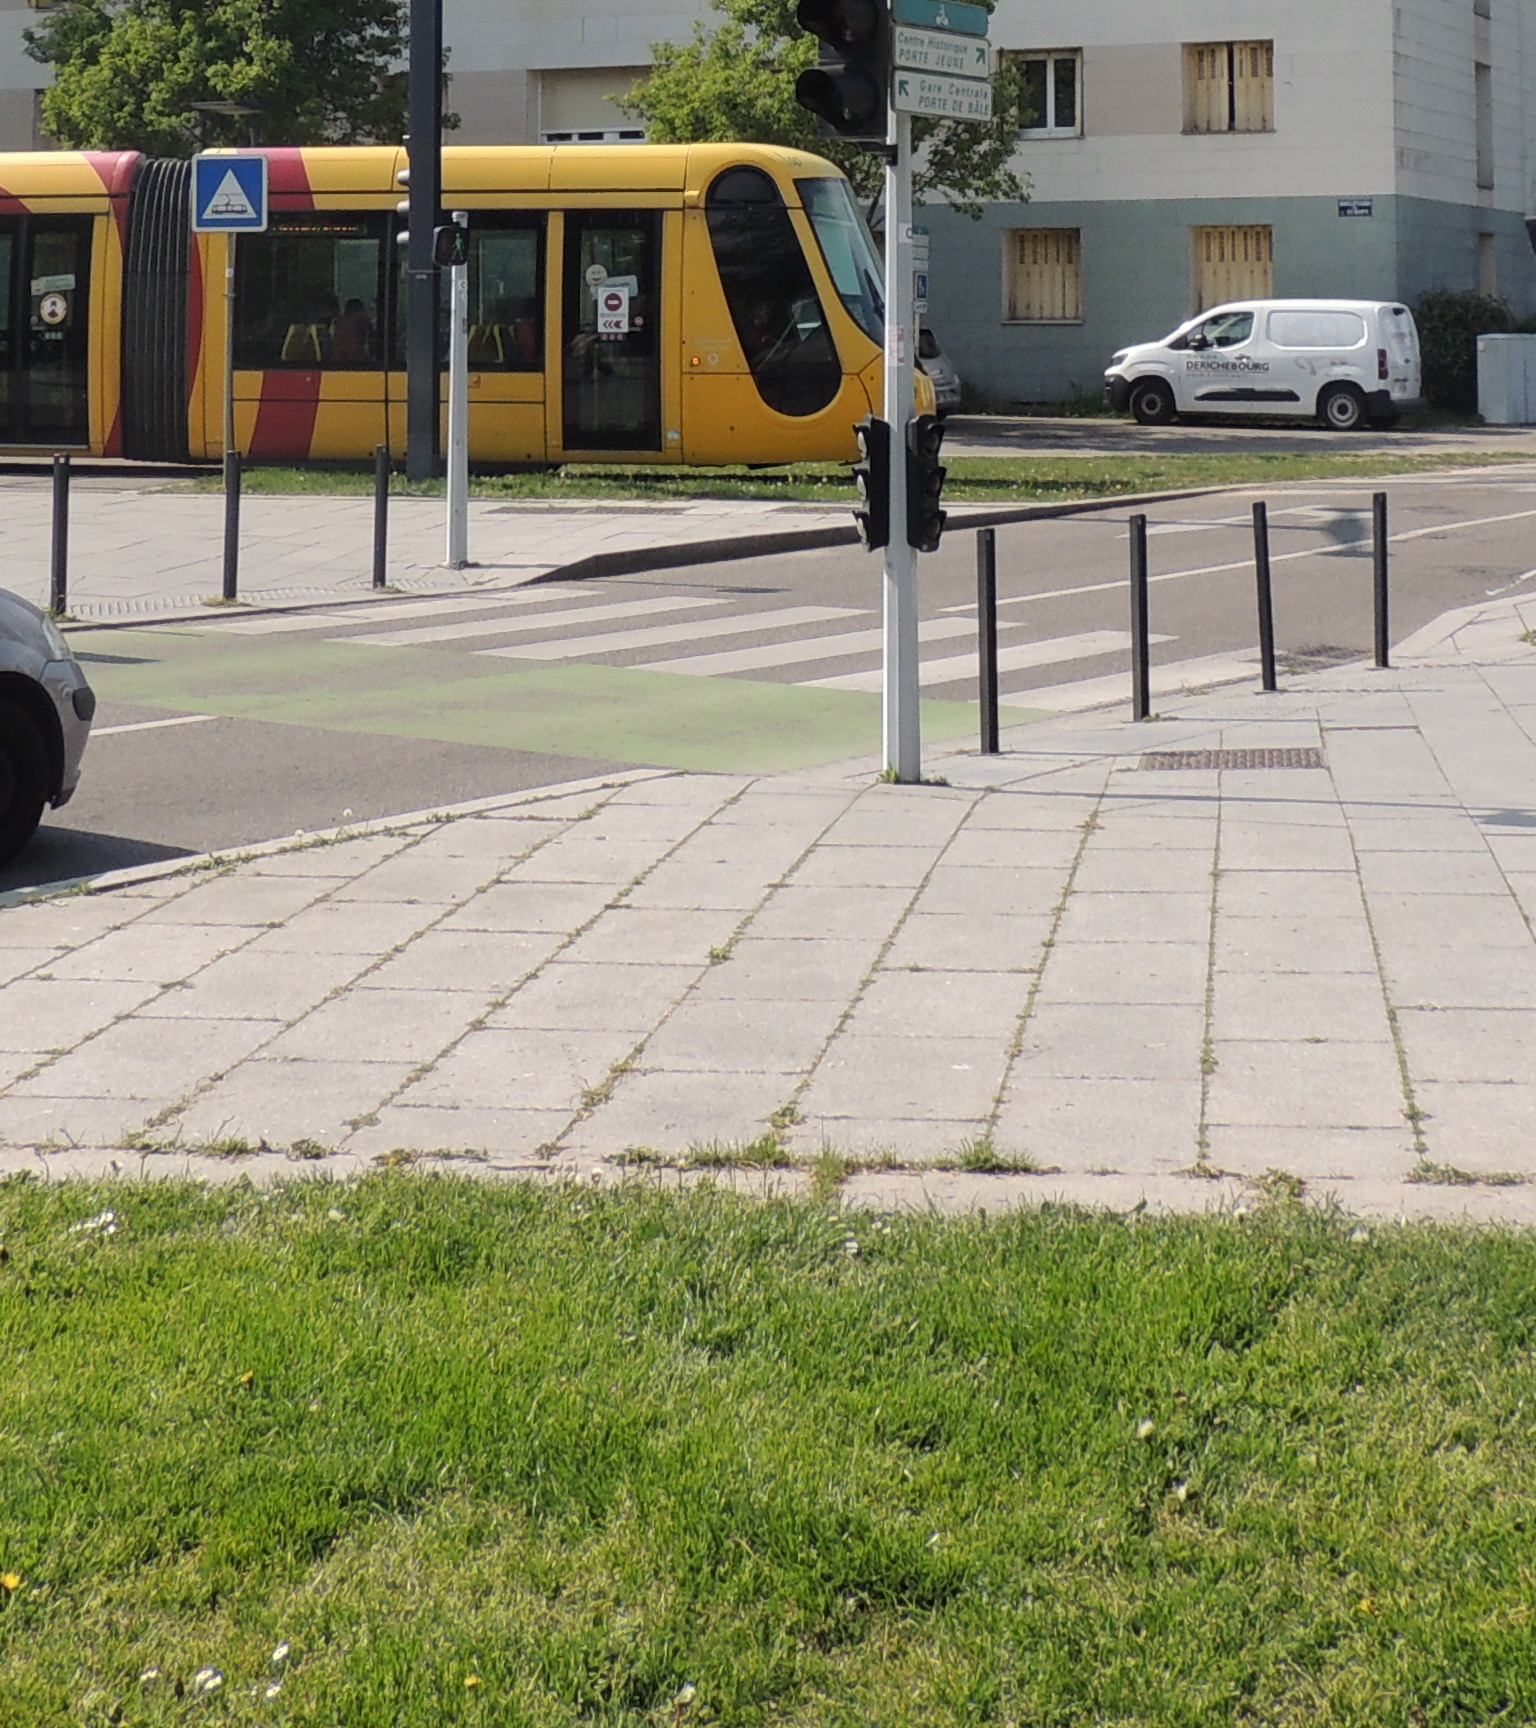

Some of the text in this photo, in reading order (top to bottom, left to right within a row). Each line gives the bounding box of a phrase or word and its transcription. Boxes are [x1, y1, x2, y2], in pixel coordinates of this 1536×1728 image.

[898, 32, 925, 47] Centre
[898, 48, 966, 70] PORTE JEUNE
[919, 79, 989, 100] Gare Centrale
[918, 96, 990, 116] PORTE DE BÂLE
[1185, 360, 1270, 372] DERICHEBOURG
